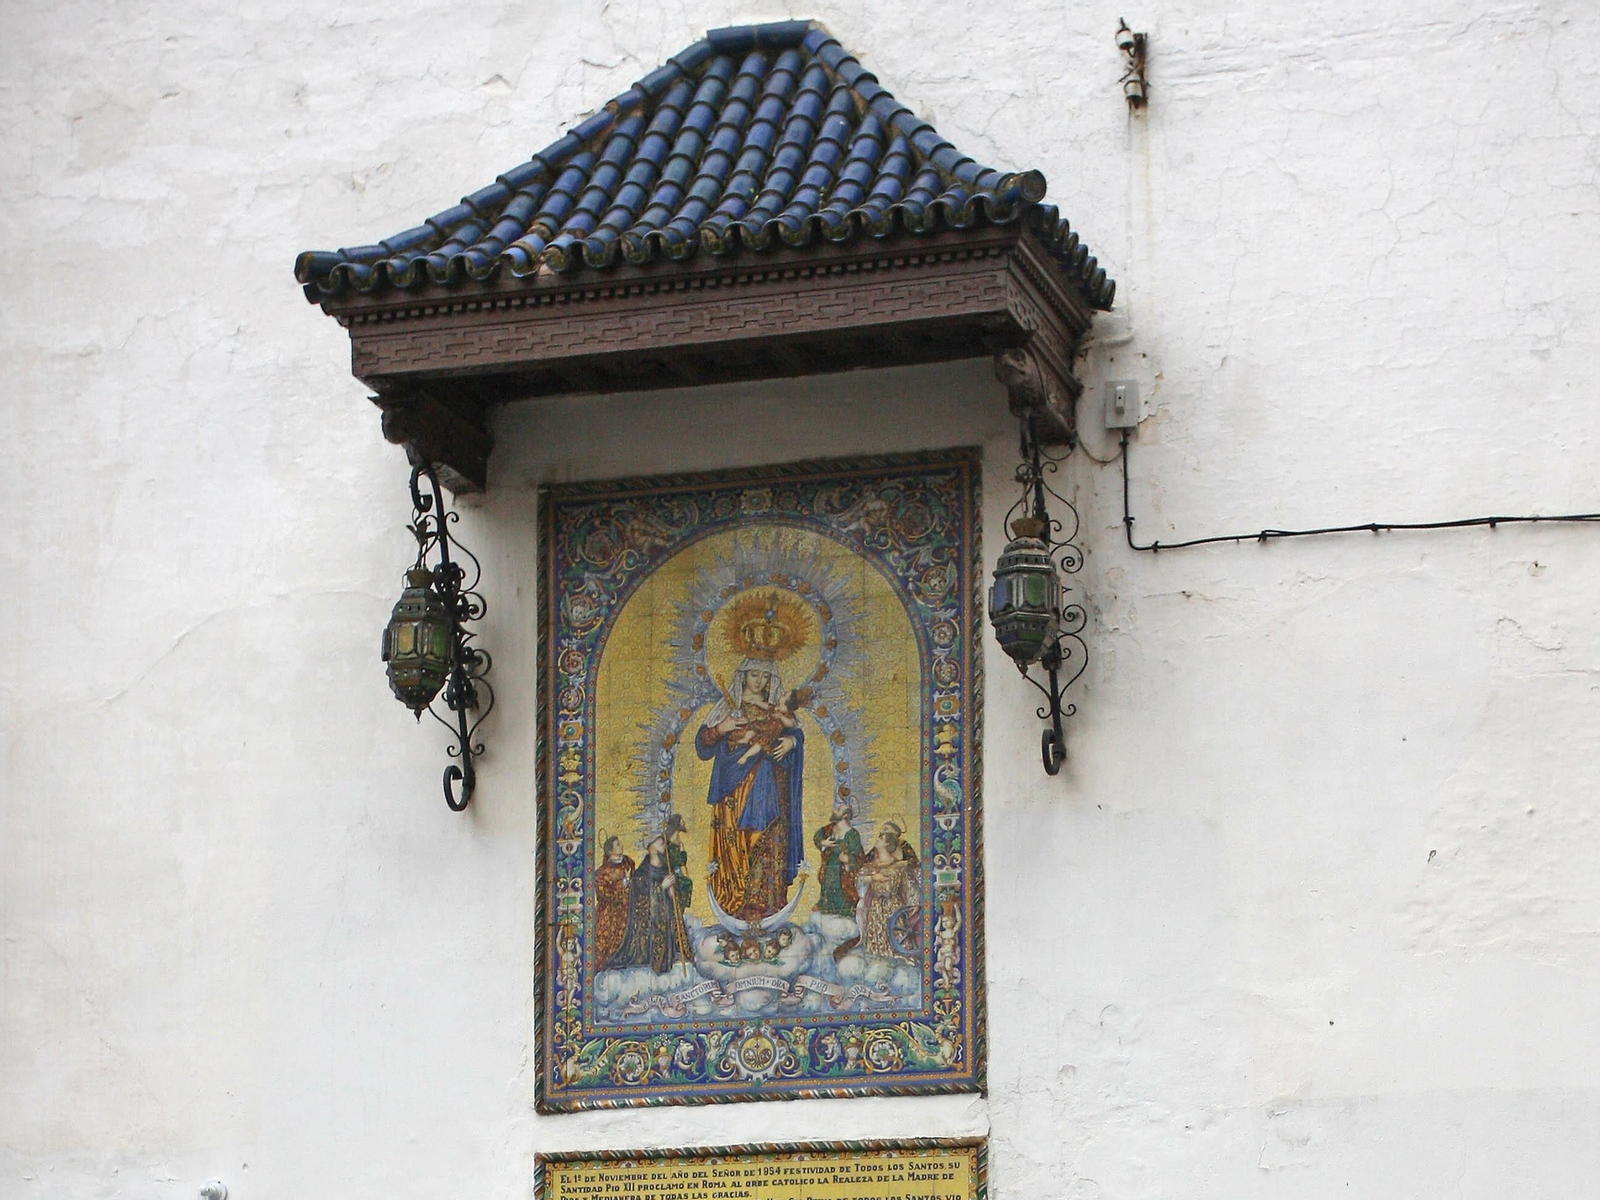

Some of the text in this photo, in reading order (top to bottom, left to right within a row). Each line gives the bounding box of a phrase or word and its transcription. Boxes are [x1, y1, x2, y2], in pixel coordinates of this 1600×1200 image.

[675, 981, 719, 1003] SANCTORUM
[735, 978, 765, 988] OMNIUM
[771, 979, 786, 990] ORA
[671, 1170, 689, 1179] AÑO
[783, 1167, 836, 1175] FESTIVIDAD
[623, 1183, 635, 1191] XII
[772, 1178, 815, 1186] CATOLICO
